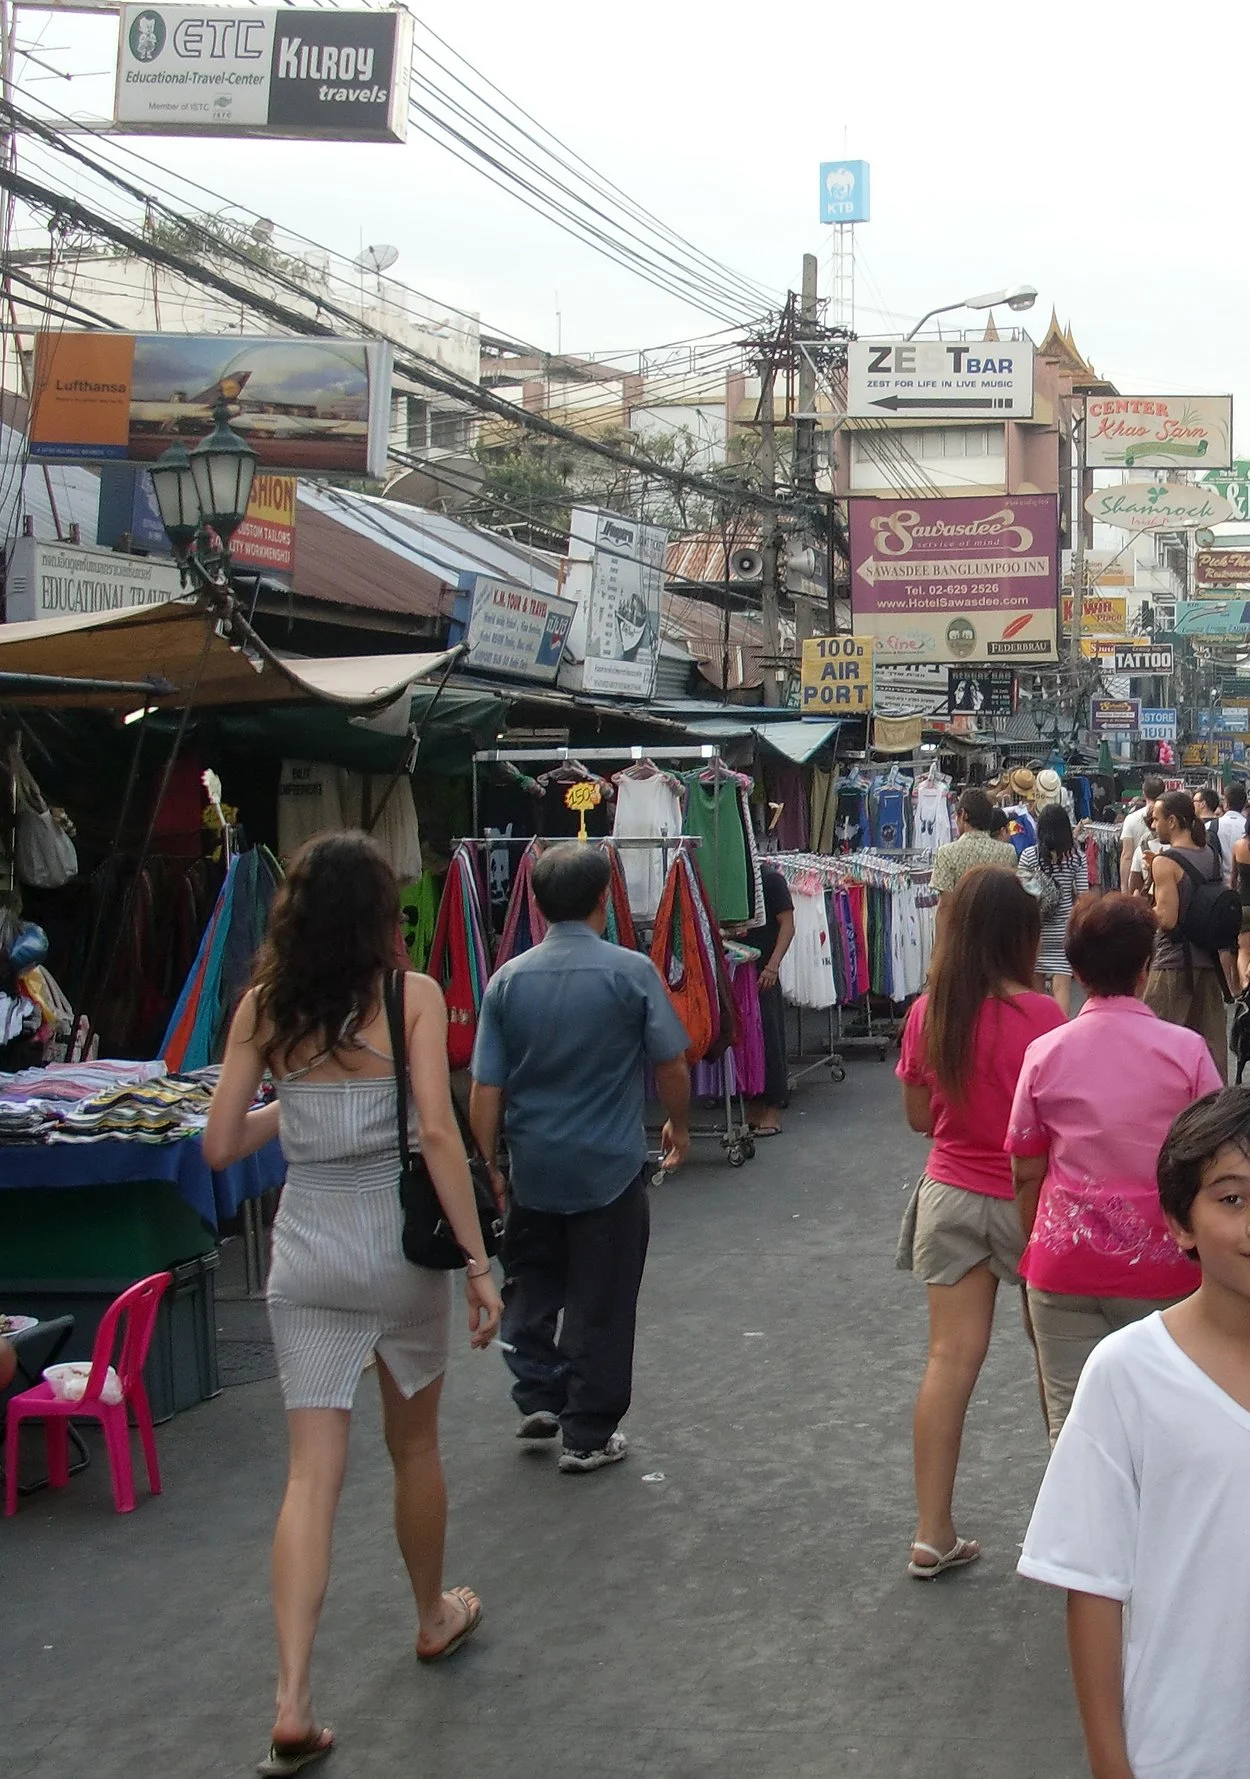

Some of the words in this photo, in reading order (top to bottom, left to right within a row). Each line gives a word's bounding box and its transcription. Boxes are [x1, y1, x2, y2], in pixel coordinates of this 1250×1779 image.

[174, 19, 265, 58] ETC
[278, 37, 375, 81] KILROY
[126, 70, 265, 86] Educational-Travel-Center
[319, 84, 387, 103] travels
[148, 101, 180, 112] Member
[181, 101, 189, 111] of
[827, 202, 855, 214] KTB
[966, 358, 1013, 375] BAR
[56, 379, 127, 393] Lufthansa
[866, 380, 890, 388] ZEST
[894, 380, 914, 388] FOR
[917, 380, 937, 388] LIFE
[941, 380, 952, 388] IN
[956, 380, 977, 388] LIVE
[981, 379, 1014, 388] MUSIC
[1089, 399, 1169, 418] CENTER
[1090, 417, 1151, 440] Khao
[1100, 495, 1215, 517] Shamrock
[870, 509, 1034, 556] Sawasdee
[917, 541, 955, 549] service
[959, 539, 970, 548] of
[974, 538, 1001, 547] mind
[865, 564, 931, 578] SAWASDEE
[933, 562, 1020, 577] BANGLUMPOO
[1023, 561, 1046, 574] INN
[41, 575, 125, 613] EDUCATIONAL
[904, 585, 926, 596] Tel.
[929, 584, 968, 596] 02-629
[971, 583, 999, 594] 2526
[876, 596, 1029, 609] www.HotelSawasdee.com
[1115, 652, 1171, 668] TATTOO
[821, 662, 860, 681] AIR
[804, 684, 869, 704] PORT
